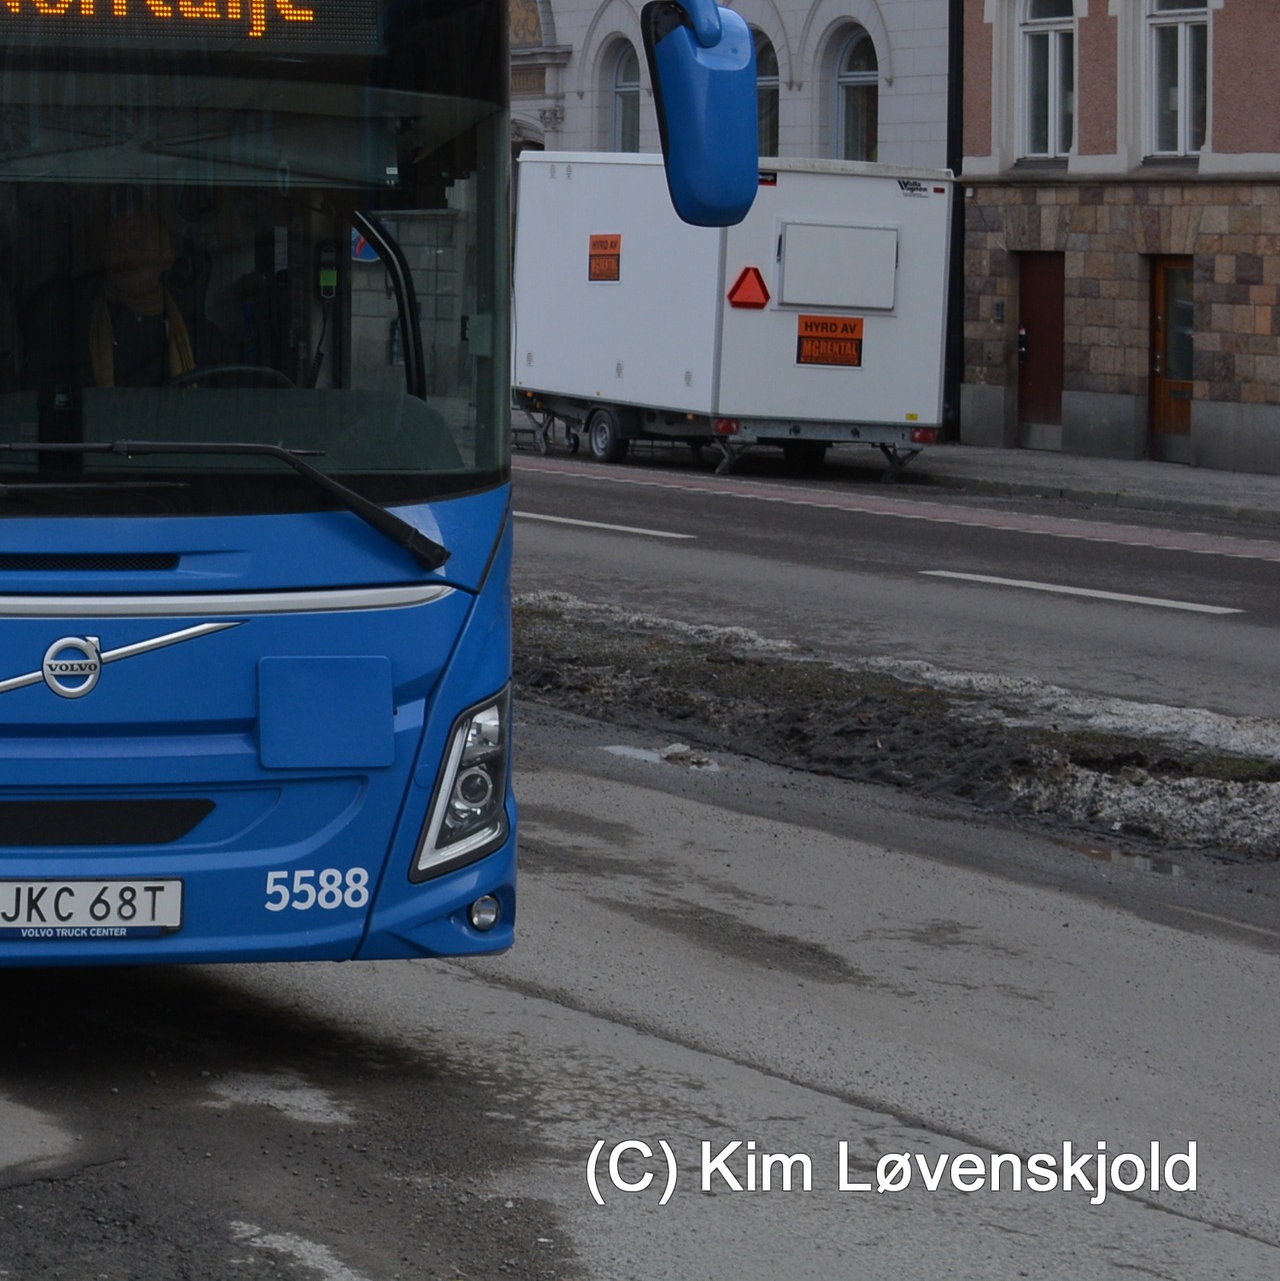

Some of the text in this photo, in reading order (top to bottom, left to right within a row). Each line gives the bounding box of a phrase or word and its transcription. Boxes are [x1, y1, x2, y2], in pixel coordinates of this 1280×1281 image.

[804, 321, 857, 334] HYRD AV
[46, 663, 98, 672] VOLVO
[264, 867, 369, 911] 5588
[1, 886, 165, 922] JKC 68T
[21, 928, 127, 937] VOLVO TRUCK CENTER
